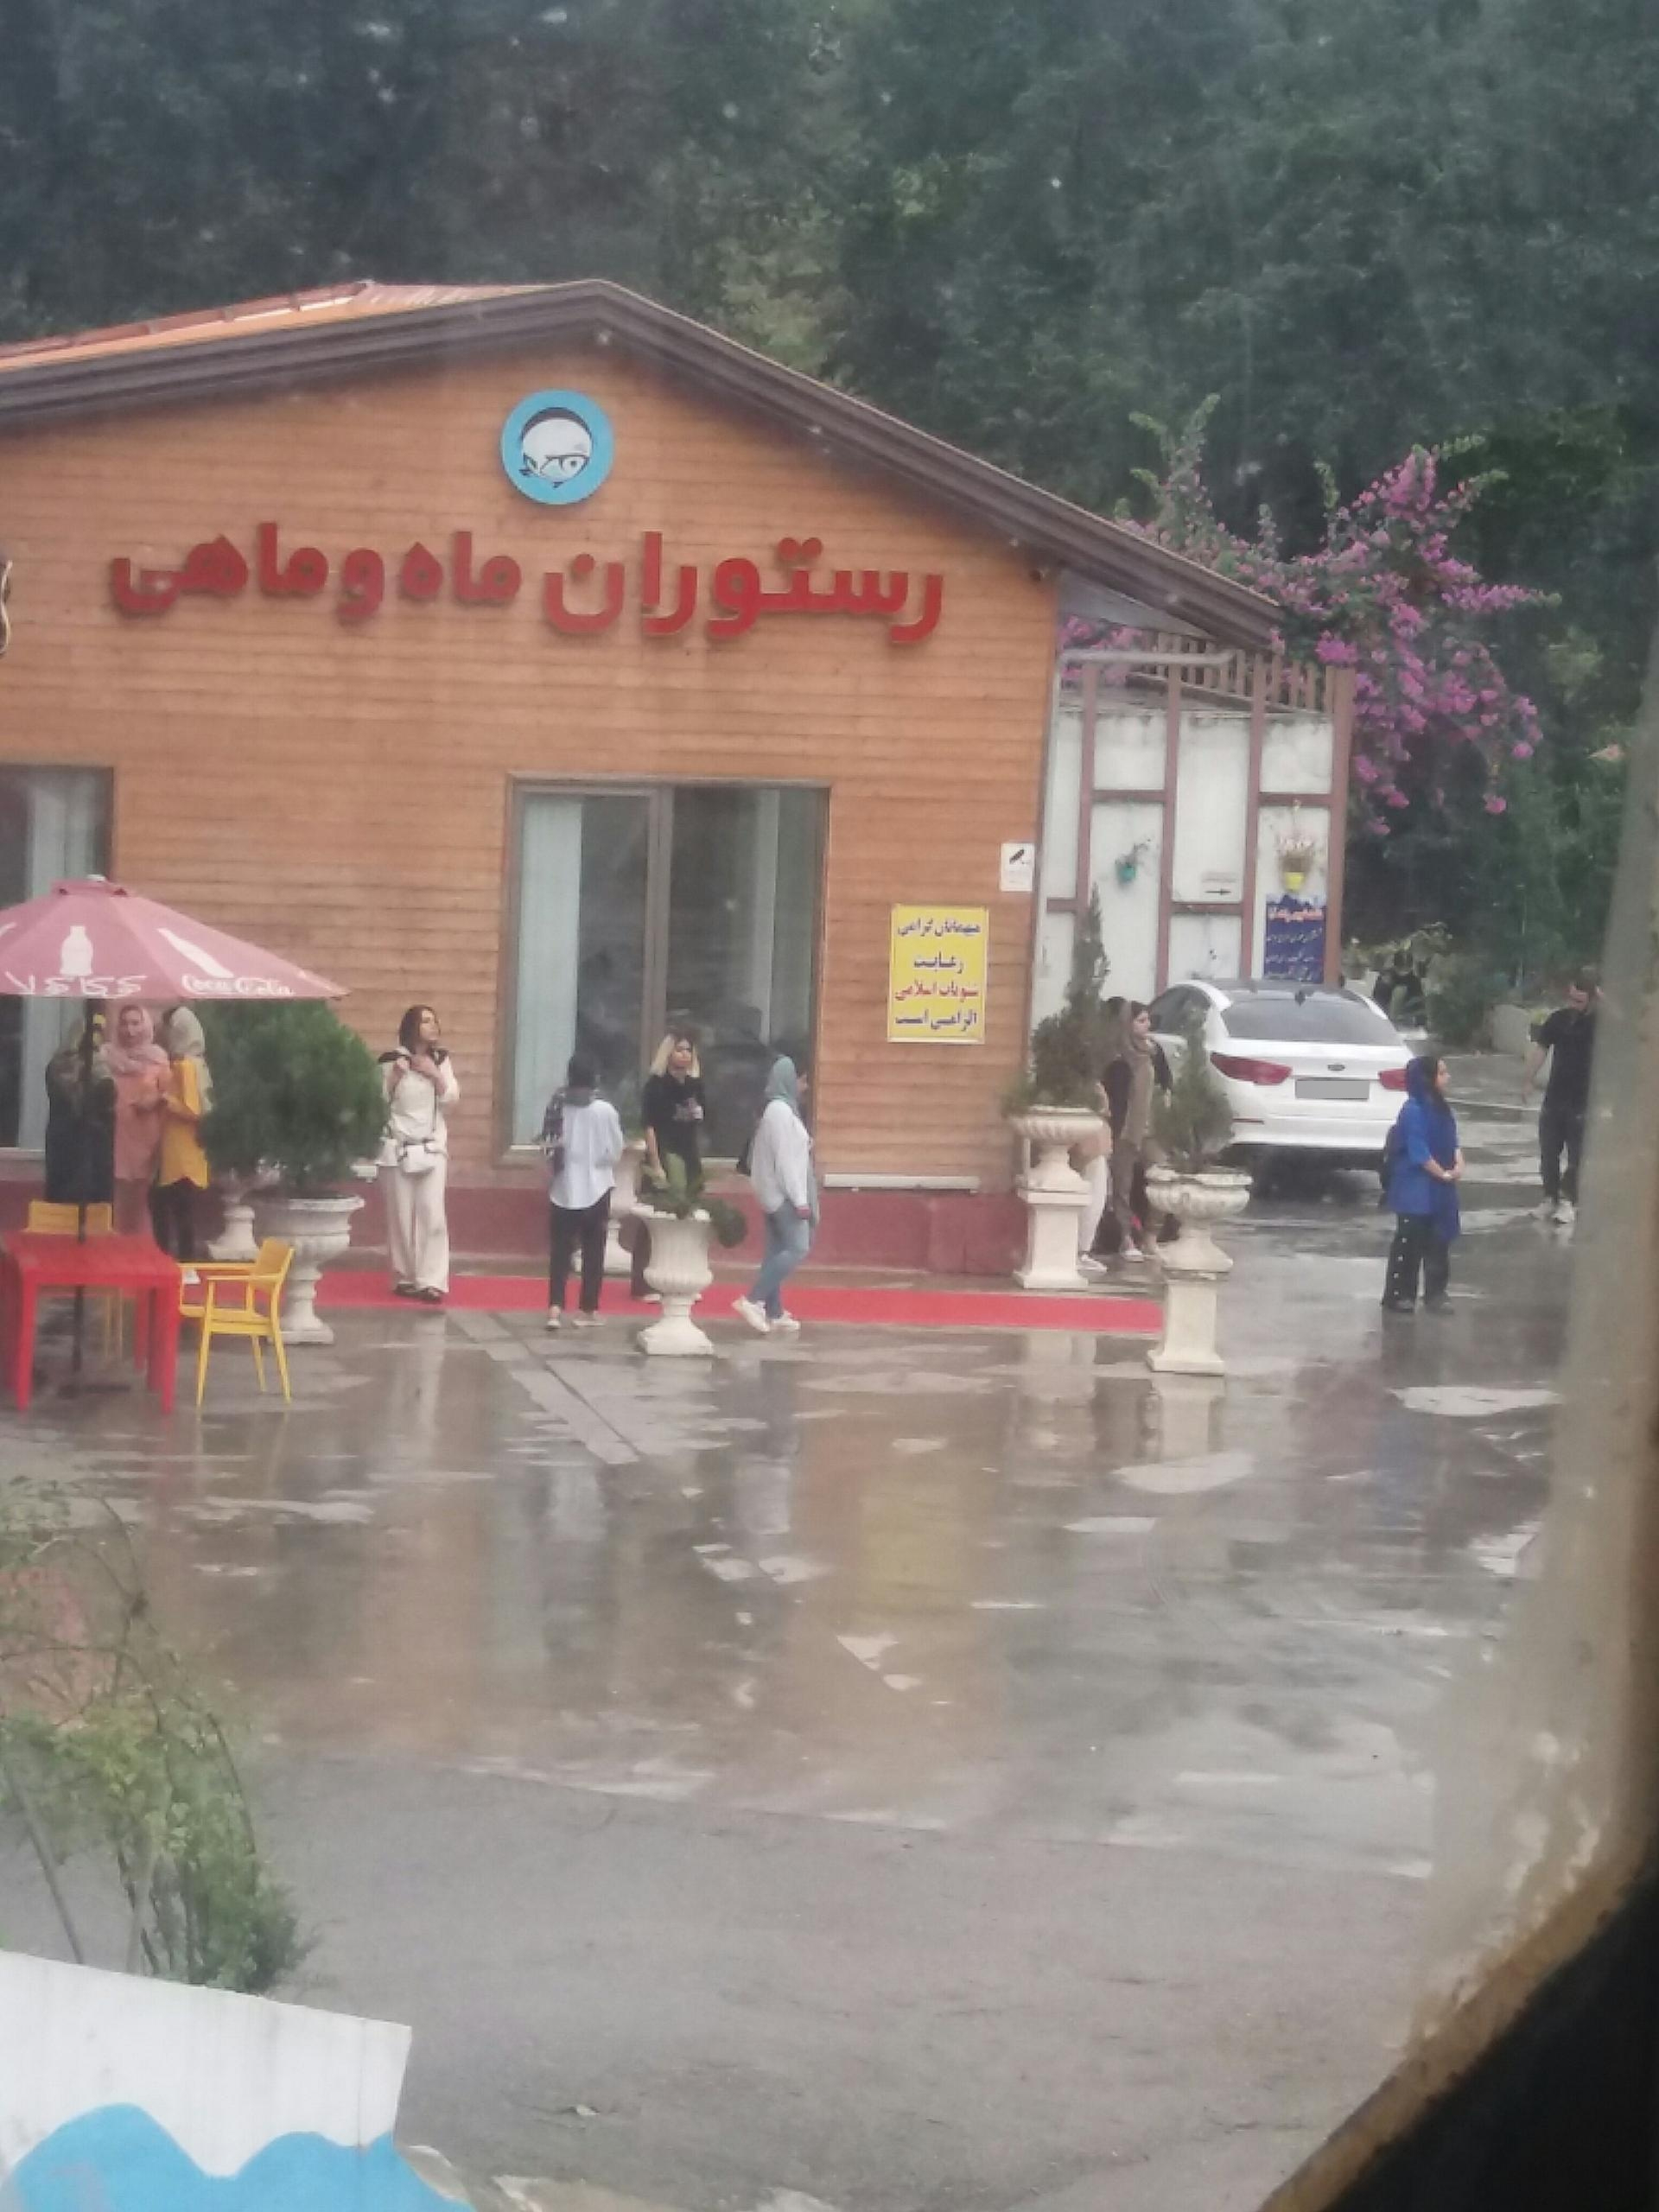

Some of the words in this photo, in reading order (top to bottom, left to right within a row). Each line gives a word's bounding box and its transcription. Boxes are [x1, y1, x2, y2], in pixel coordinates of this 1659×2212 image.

[111, 522, 329, 615] ماهی
[337, 547, 386, 623] و
[401, 530, 523, 604] ماه
[543, 530, 944, 645] رستوران
[914, 951, 964, 974] رعایت
